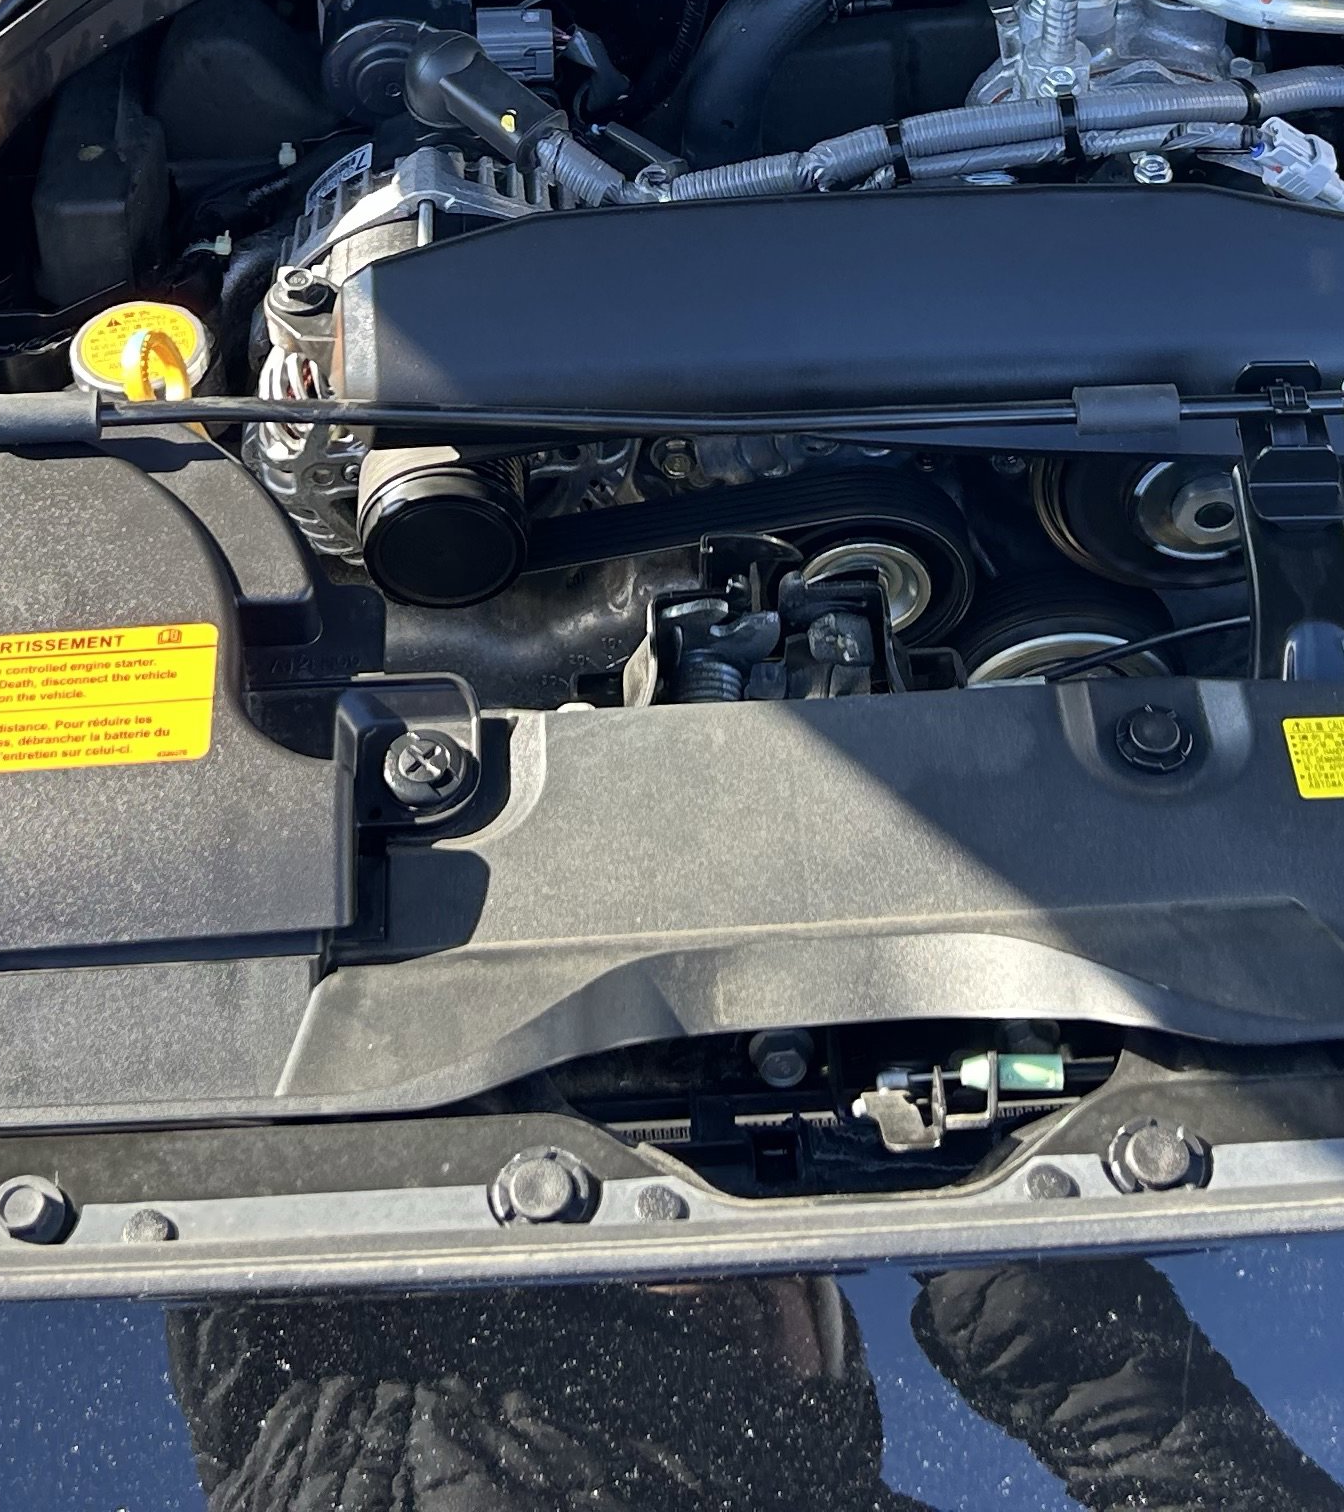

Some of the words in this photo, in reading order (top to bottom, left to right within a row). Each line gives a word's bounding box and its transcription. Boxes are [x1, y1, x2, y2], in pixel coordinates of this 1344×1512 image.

[6, 662, 68, 676] controlled
[70, 660, 112, 675] engine
[114, 658, 157, 670] starter.
[0, 678, 37, 690] Death,
[41, 674, 108, 688] disconnect
[111, 672, 131, 683] the
[134, 668, 177, 681] vehicle
[16, 691, 37, 702] the
[39, 687, 87, 701] vehicle.
[55, 718, 85, 730] Pour
[88, 715, 132, 728] réduire
[135, 714, 153, 725] les
[18, 732, 88, 746] débrancher
[89, 731, 101, 742] la
[104, 728, 151, 741] batterie
[154, 726, 171, 737] du
[61, 747, 83, 758] sur
[85, 744, 134, 757] celui-ci.
